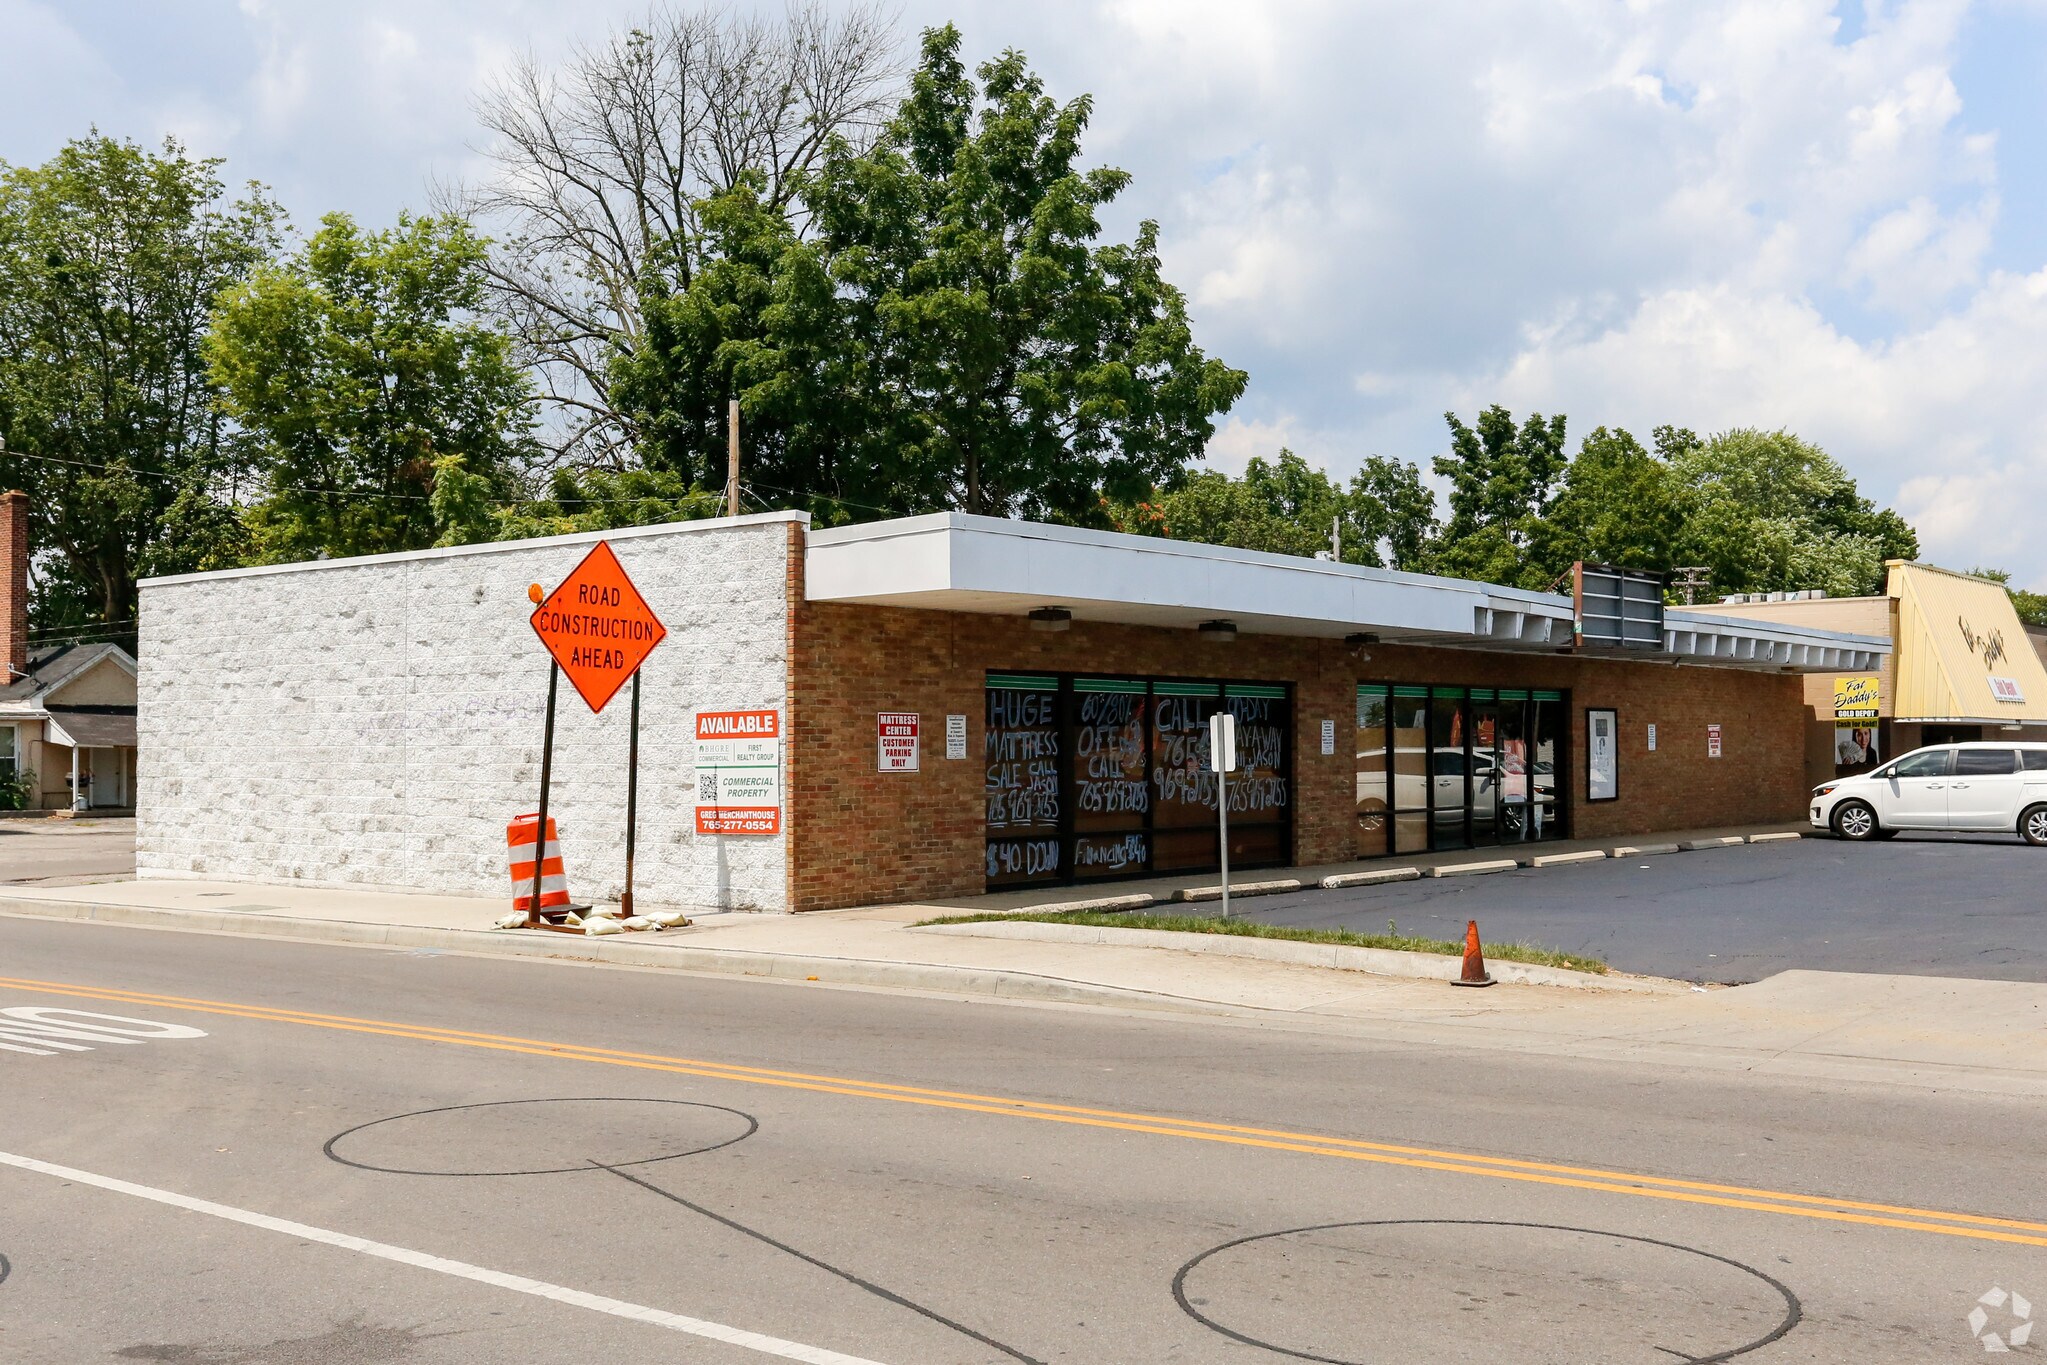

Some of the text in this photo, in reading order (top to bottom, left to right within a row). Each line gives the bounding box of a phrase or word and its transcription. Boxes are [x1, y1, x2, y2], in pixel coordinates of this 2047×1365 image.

[579, 584, 620, 607] ROAD
[540, 612, 653, 641] CONSTRUCTION
[571, 647, 624, 669] AHEAD
[1846, 679, 1866, 692] Fat
[1834, 690, 1878, 708] Daddy's
[991, 690, 1053, 728] HUGE
[1155, 698, 1210, 731] CALL
[700, 715, 774, 734] AVAILABLE
[880, 715, 917, 725] MATTRESS
[885, 726, 912, 735] CENTER
[705, 744, 729, 753] BHGRE
[748, 744, 762, 752] FIRST
[882, 738, 915, 747] CUSTOMER
[984, 730, 1059, 762] MATTRESS
[1078, 726, 1120, 757] OFF
[737, 753, 775, 761] REALTY GROUP
[885, 749, 912, 757] PARKING
[1249, 748, 1280, 769] JASON
[891, 758, 907, 767] ONLY
[1088, 755, 1125, 778] CALL
[722, 777, 774, 786] COMMERCIAL
[984, 760, 1059, 789] SALE CALL
[727, 789, 769, 797] PROPERTY
[1027, 776, 1059, 795] JASON
[700, 810, 775, 819] GREG MERCHANTHOUSE
[702, 820, 773, 829] 765-277-0554
